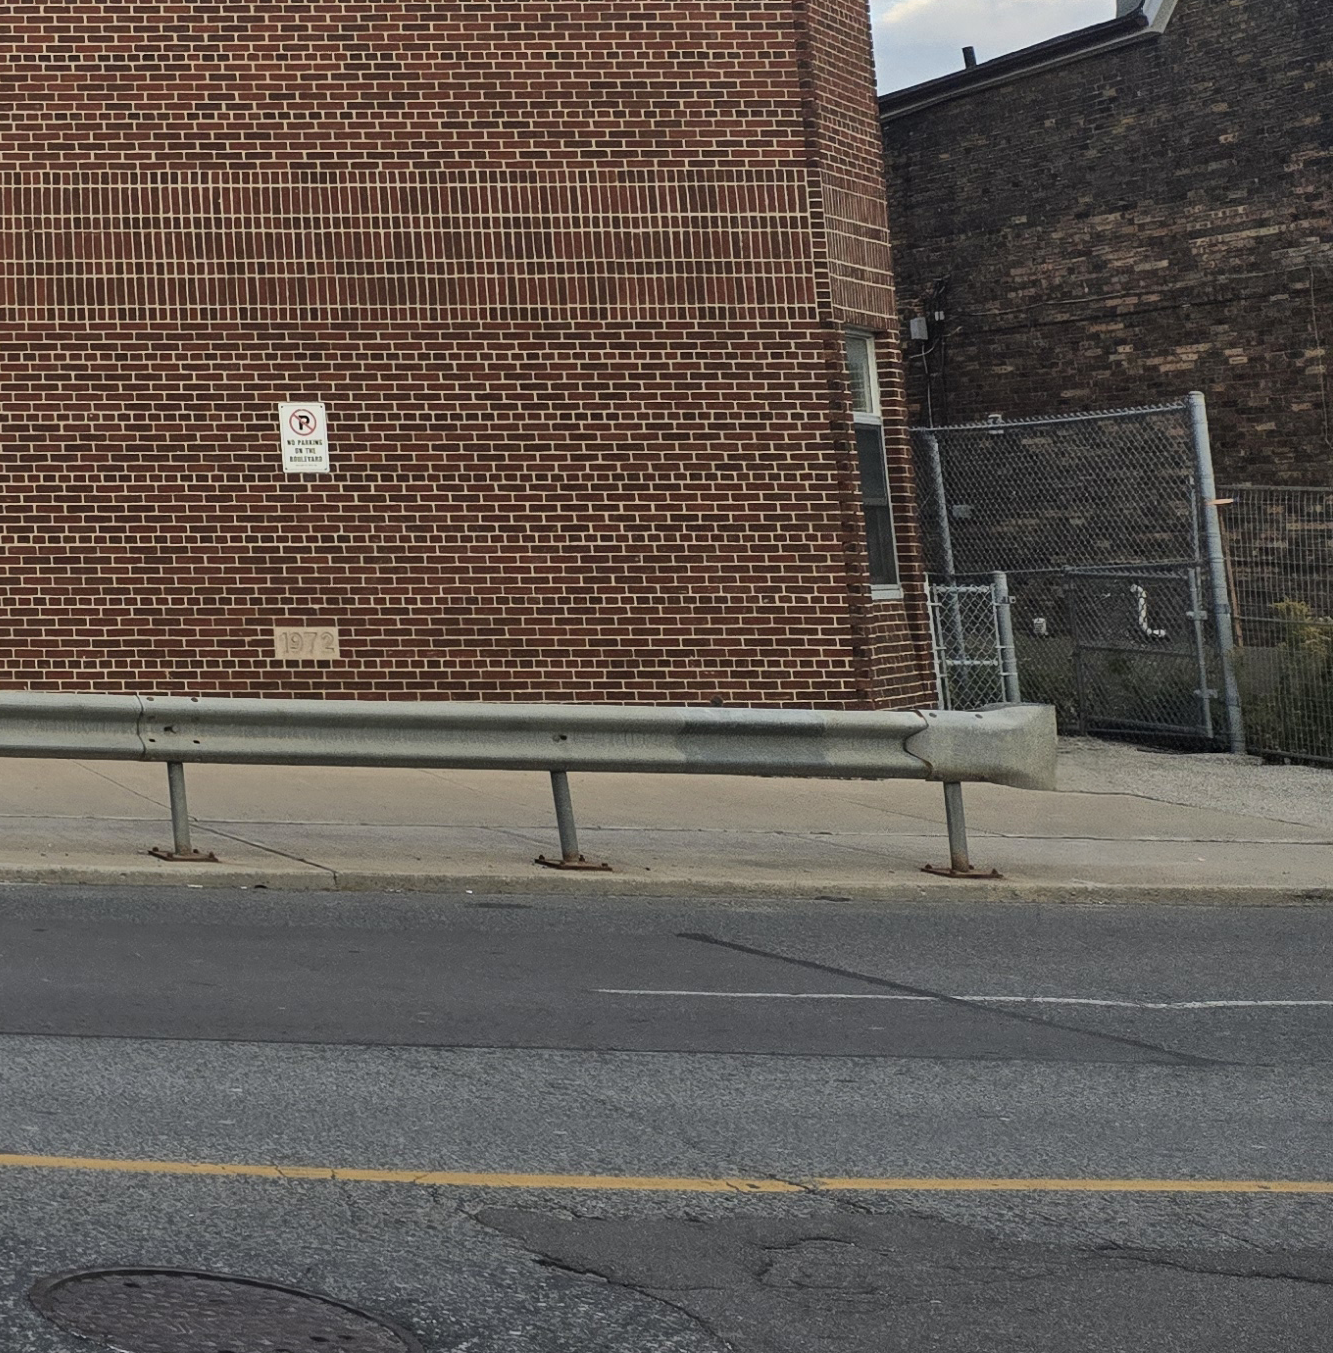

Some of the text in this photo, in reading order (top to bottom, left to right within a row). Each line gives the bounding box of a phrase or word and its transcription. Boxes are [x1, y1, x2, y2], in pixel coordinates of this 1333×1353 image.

[304, 447, 317, 455] THE
[289, 455, 323, 463] BOULEVARD
[278, 631, 336, 654] 1972
